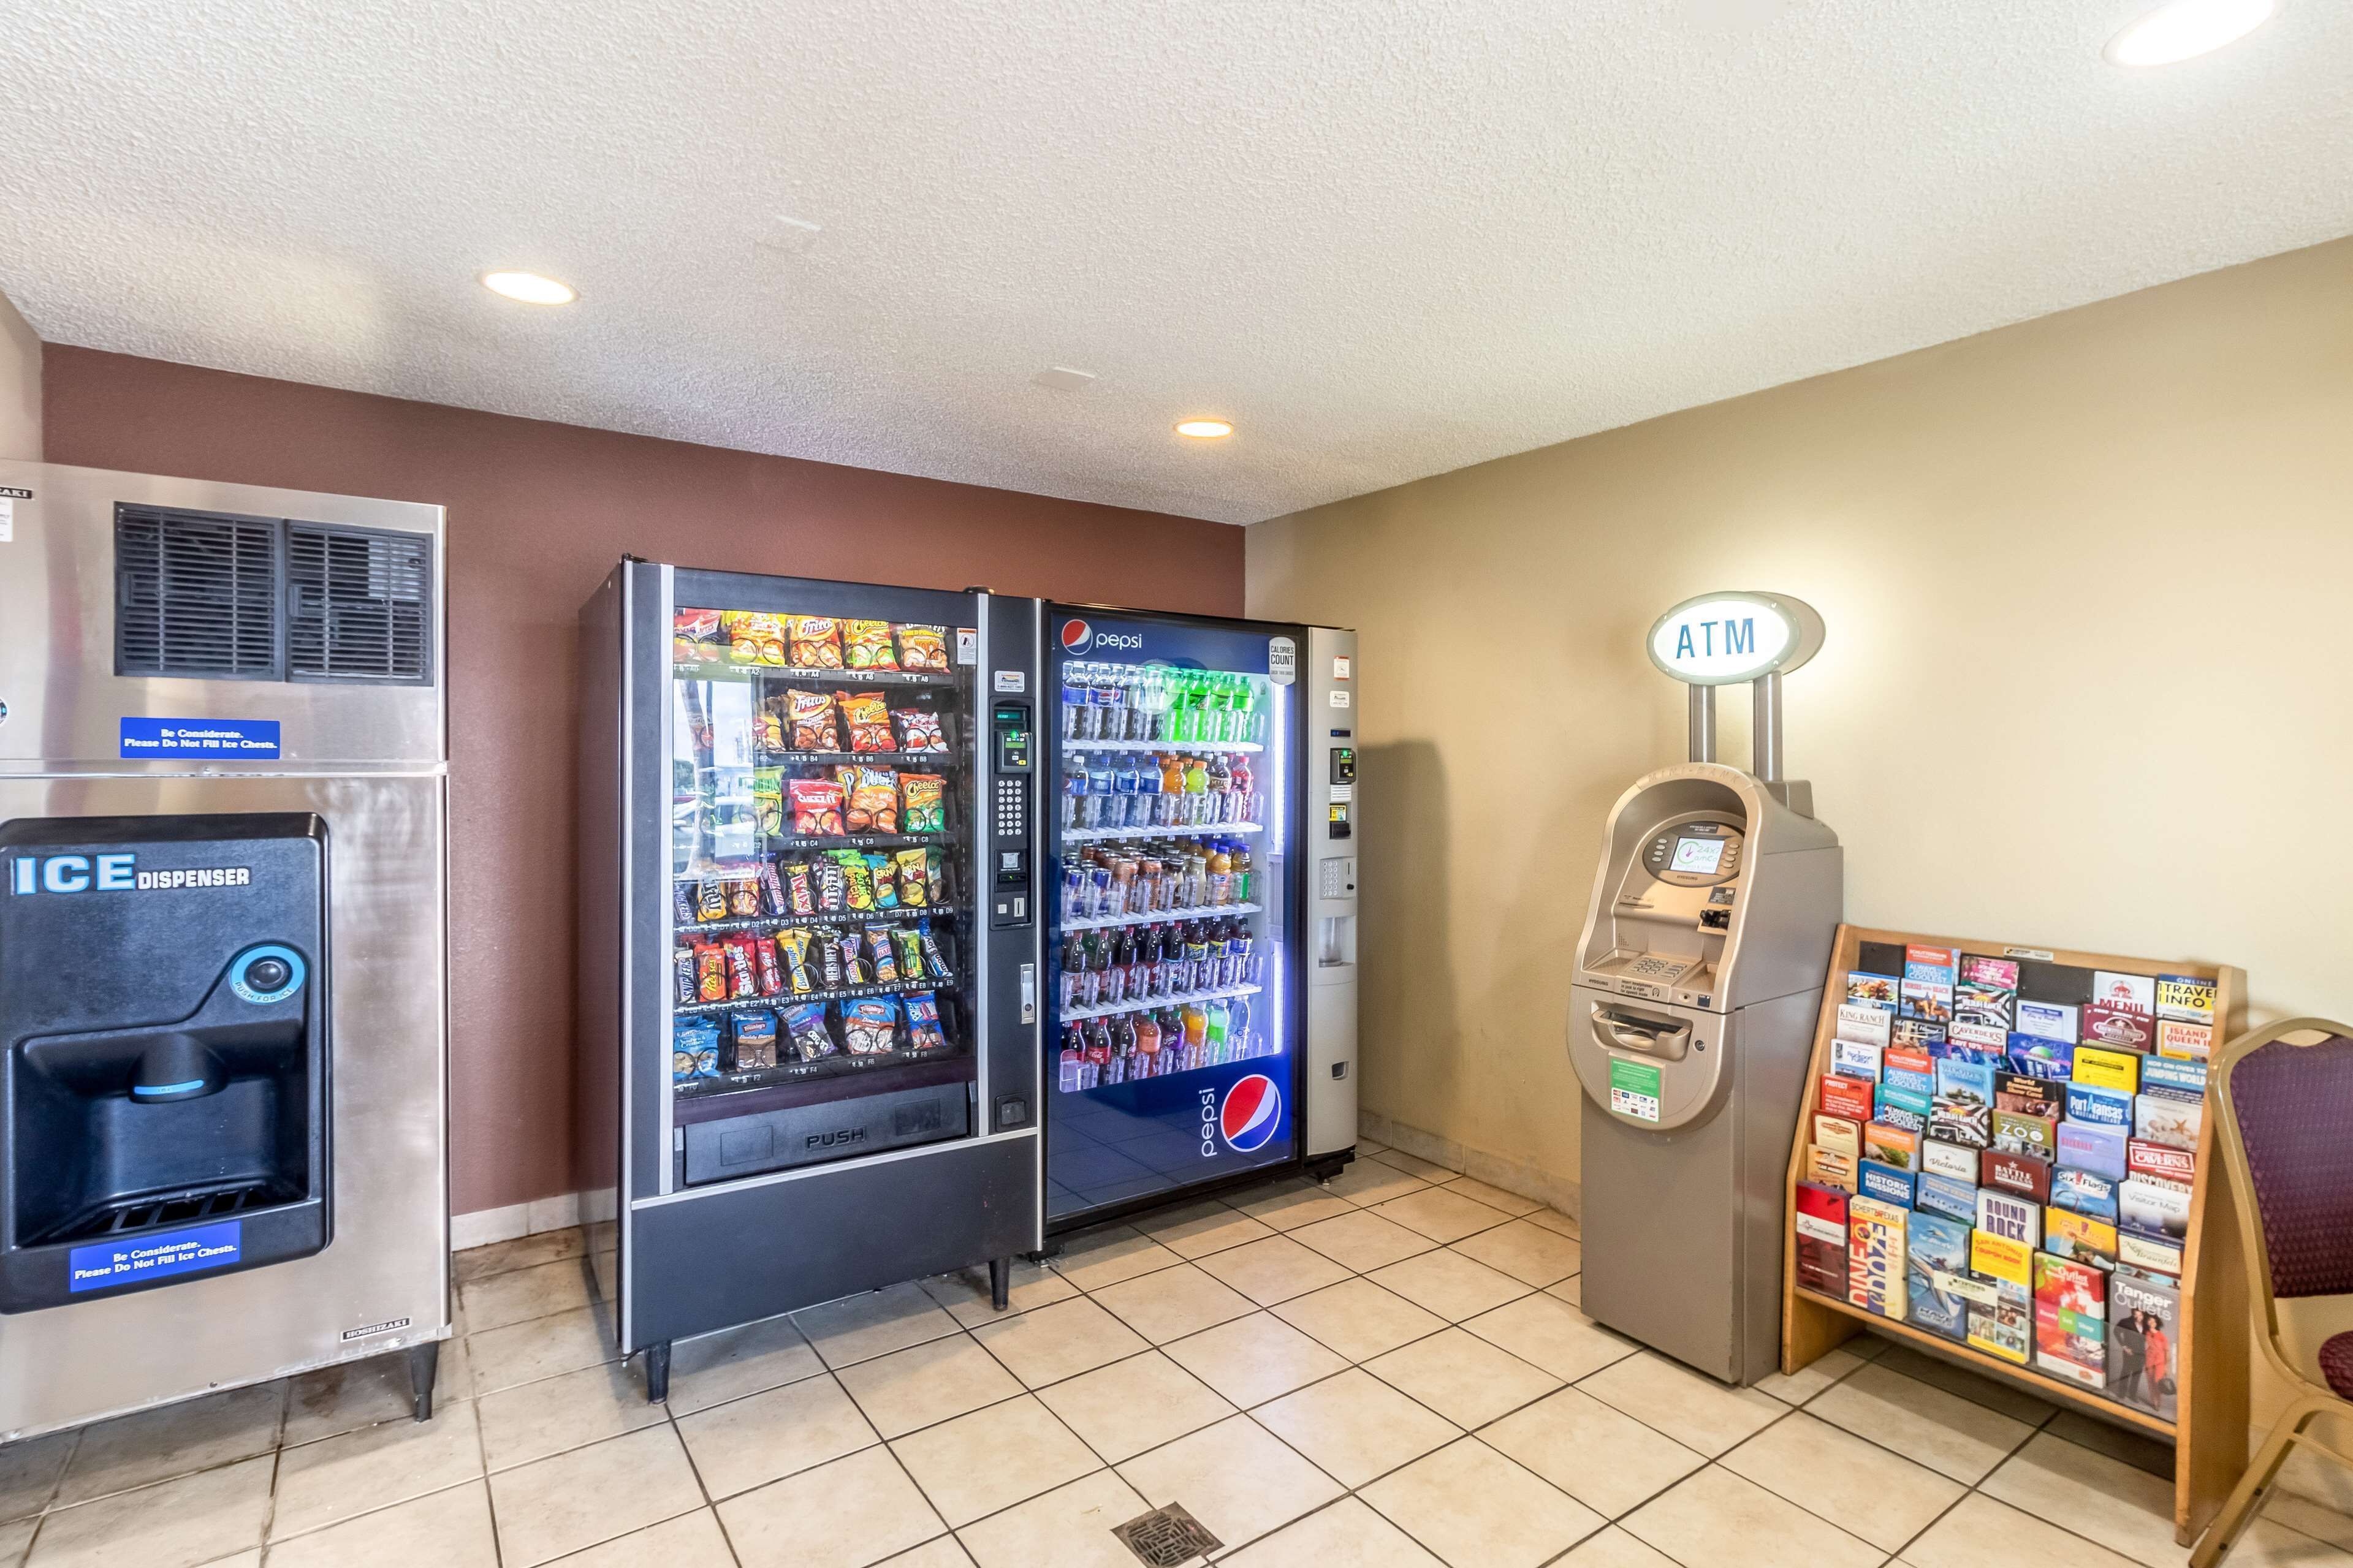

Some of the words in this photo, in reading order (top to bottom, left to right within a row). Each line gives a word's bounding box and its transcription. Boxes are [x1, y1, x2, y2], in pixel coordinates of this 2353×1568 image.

[0, 488, 27, 498] AKI
[1096, 633, 1142, 650] pepsi
[1676, 618, 1755, 659] ATM
[1271, 645, 1294, 654] CALORIES
[1271, 654, 1294, 665] COUNT
[854, 701, 886, 724] Cheetos
[161, 729, 175, 737] Be
[177, 729, 244, 738] Considerate.
[124, 738, 160, 747] Please
[162, 739, 178, 748] Do
[180, 739, 200, 748] Not
[202, 739, 219, 748] Fill
[222, 740, 238, 748] Ice
[240, 740, 278, 749] Chests.
[907, 780, 941, 797] Cheetos
[16, 854, 136, 895] ICE
[137, 868, 250, 890] DISPENSER
[856, 873, 867, 895] SOUR
[791, 873, 811, 912] TWIX
[682, 958, 694, 998] SNICKERS
[734, 945, 755, 996] Skittles
[235, 981, 254, 999] PUSH
[2176, 977, 2213, 987] ONLINE
[2165, 994, 2205, 1008] INFO
[1839, 1009, 1858, 1020] KING
[1860, 1013, 1885, 1025] RANCH
[1952, 1025, 2002, 1042] CAVENDER'S
[2167, 1035, 2200, 1045] QUEEN
[2170, 1027, 2207, 1038] ISLAND
[1888, 1078, 1927, 1091] COOLEST
[1884, 1105, 1912, 1115] ALWAYS
[2070, 1095, 2088, 1110] Port
[2088, 1094, 2123, 1120] Aransas
[1198, 1088, 1218, 1157] pepsi
[1884, 1115, 1924, 1133] COOLEST
[805, 1126, 866, 1149] PUSH
[2000, 1123, 2044, 1142] ZOO
[1929, 1157, 1967, 1173] Victoria
[1865, 1172, 1910, 1191] HISTORIC
[1865, 1180, 1910, 1199] MISSIONS
[2058, 1173, 2074, 1181] Six
[2083, 1178, 2110, 1192] Flags
[2129, 1170, 2193, 1195] DISCOVERY
[1986, 1198, 2026, 1224] ROUND
[2128, 1194, 2157, 1206] Visitor
[2159, 1202, 2180, 1214] Map
[1986, 1214, 2026, 1243] ROCK
[113, 1253, 127, 1263] Be
[131, 1241, 201, 1260] Considerate.
[1991, 1240, 2023, 1258] ANTONIO
[74, 1266, 111, 1280] Please
[114, 1263, 131, 1273] Do
[133, 1259, 155, 1270] Not
[158, 1255, 175, 1265] Fill
[178, 1252, 195, 1262] Ice
[197, 1244, 237, 1258] Chests.
[1849, 1243, 1868, 1309] DINE
[2115, 1281, 2173, 1308] Tanger
[2115, 1292, 2172, 1321] Outlets
[346, 1319, 407, 1338] HOSHIZAKI
